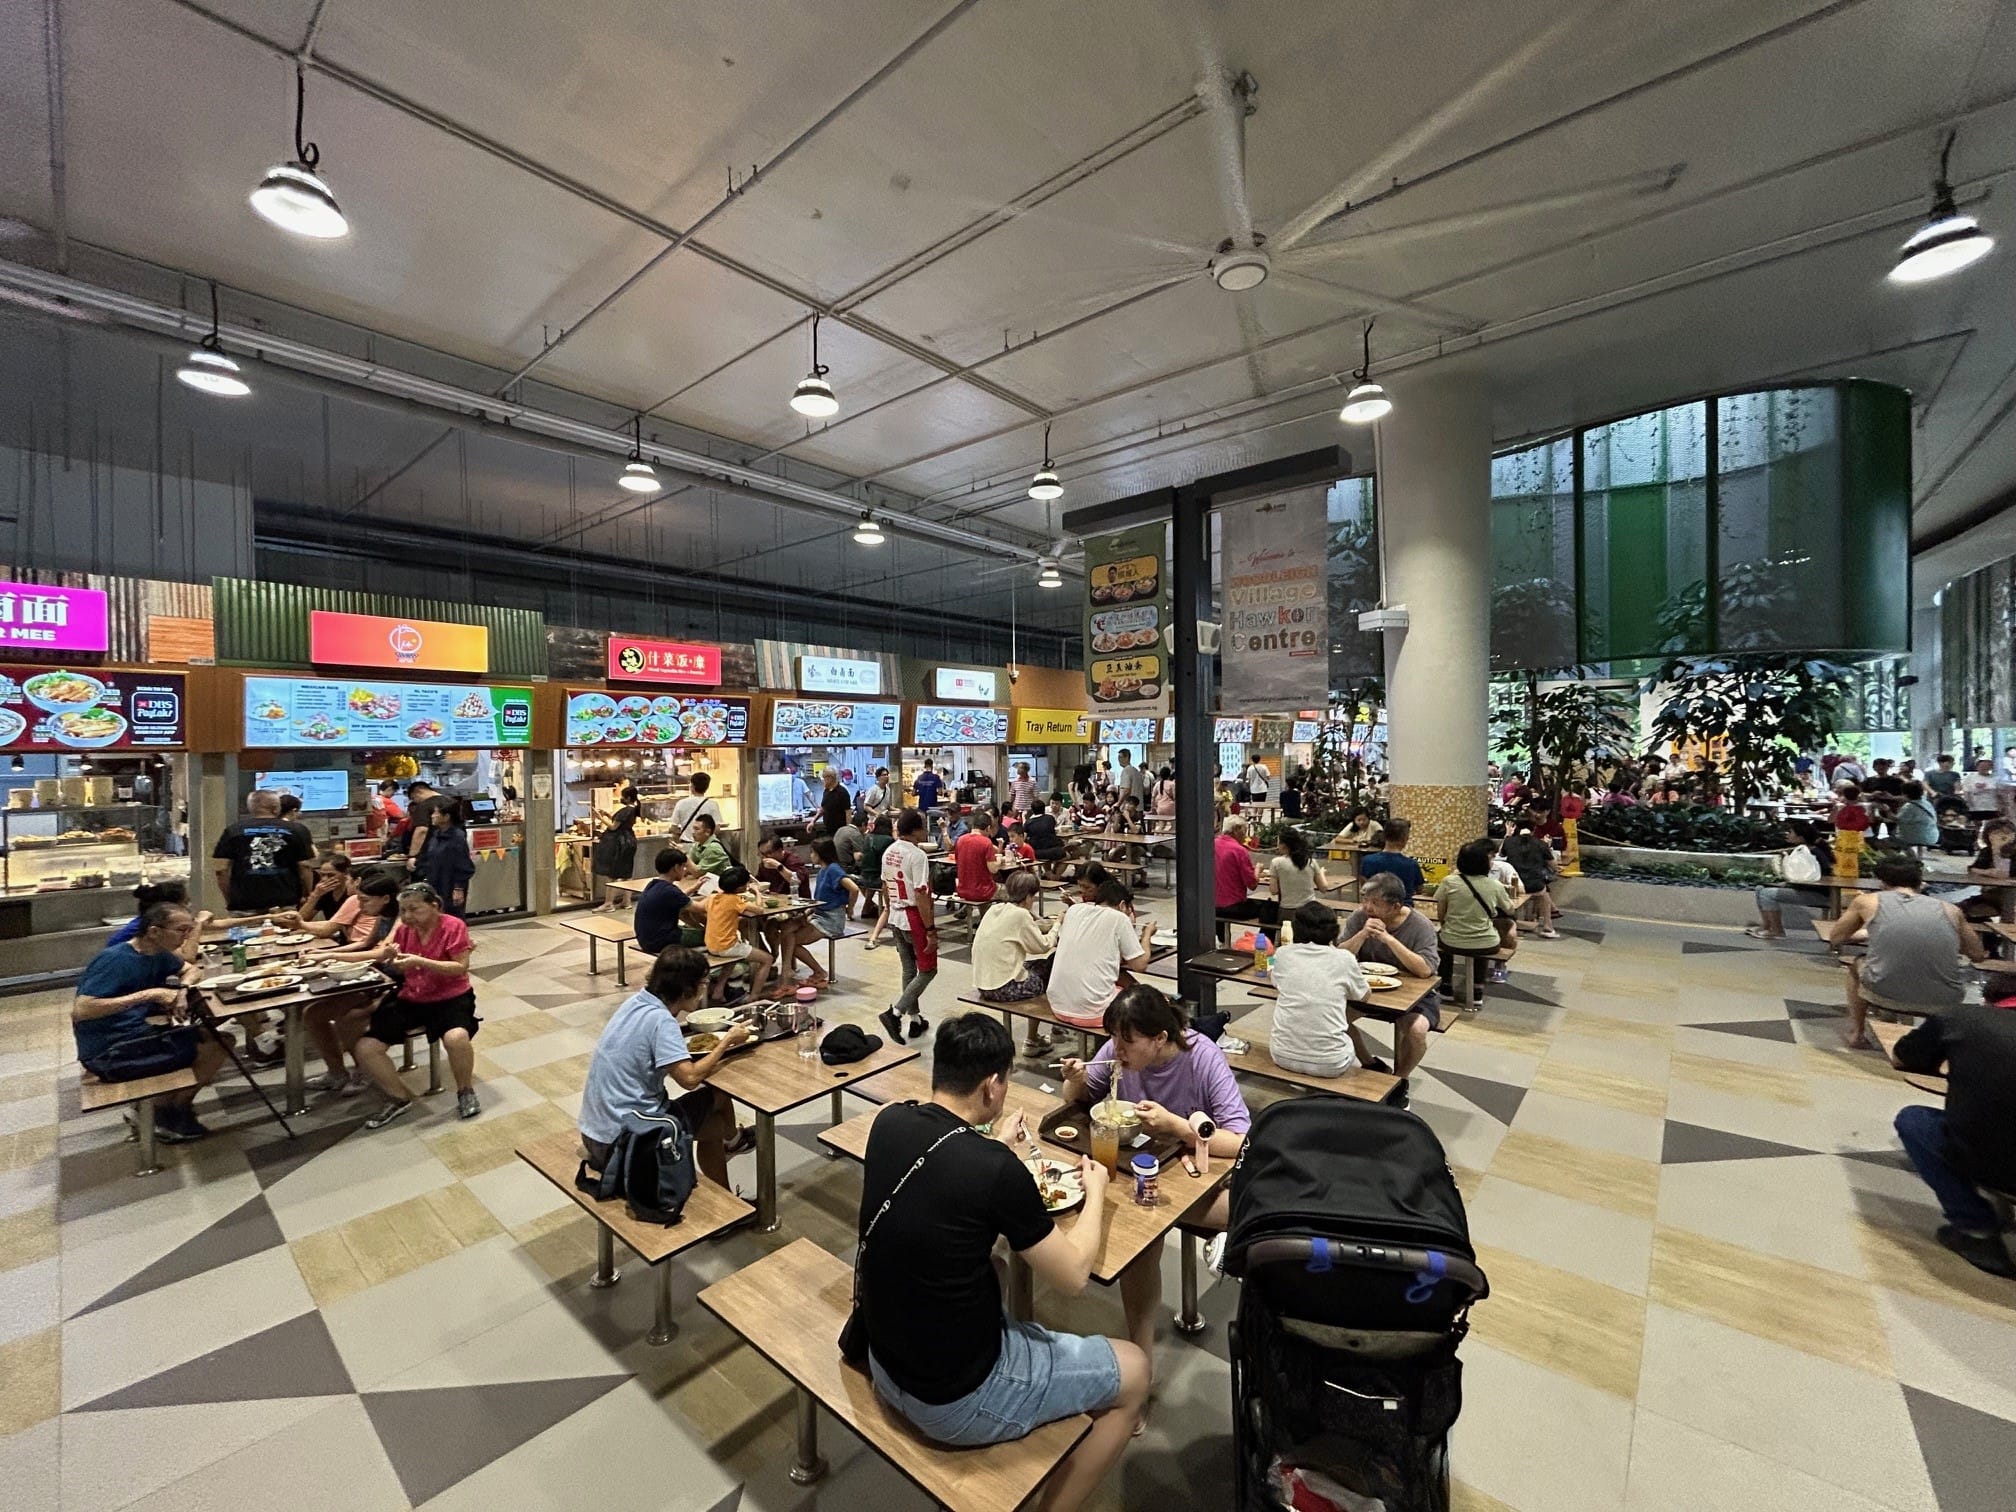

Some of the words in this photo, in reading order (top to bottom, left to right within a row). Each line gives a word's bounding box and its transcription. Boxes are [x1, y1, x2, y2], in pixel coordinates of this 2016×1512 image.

[1230, 582, 1317, 605] Village
[1229, 606, 1316, 630] Hawker
[11, 628, 56, 641] MEE
[1231, 628, 1316, 652] Centre
[149, 700, 173, 708] DBS
[1026, 720, 1044, 735] Tray
[1047, 721, 1073, 732] Return
[927, 1126, 967, 1152] Champion
[892, 1157, 925, 1195] Champion
[865, 1199, 891, 1236] Champion
